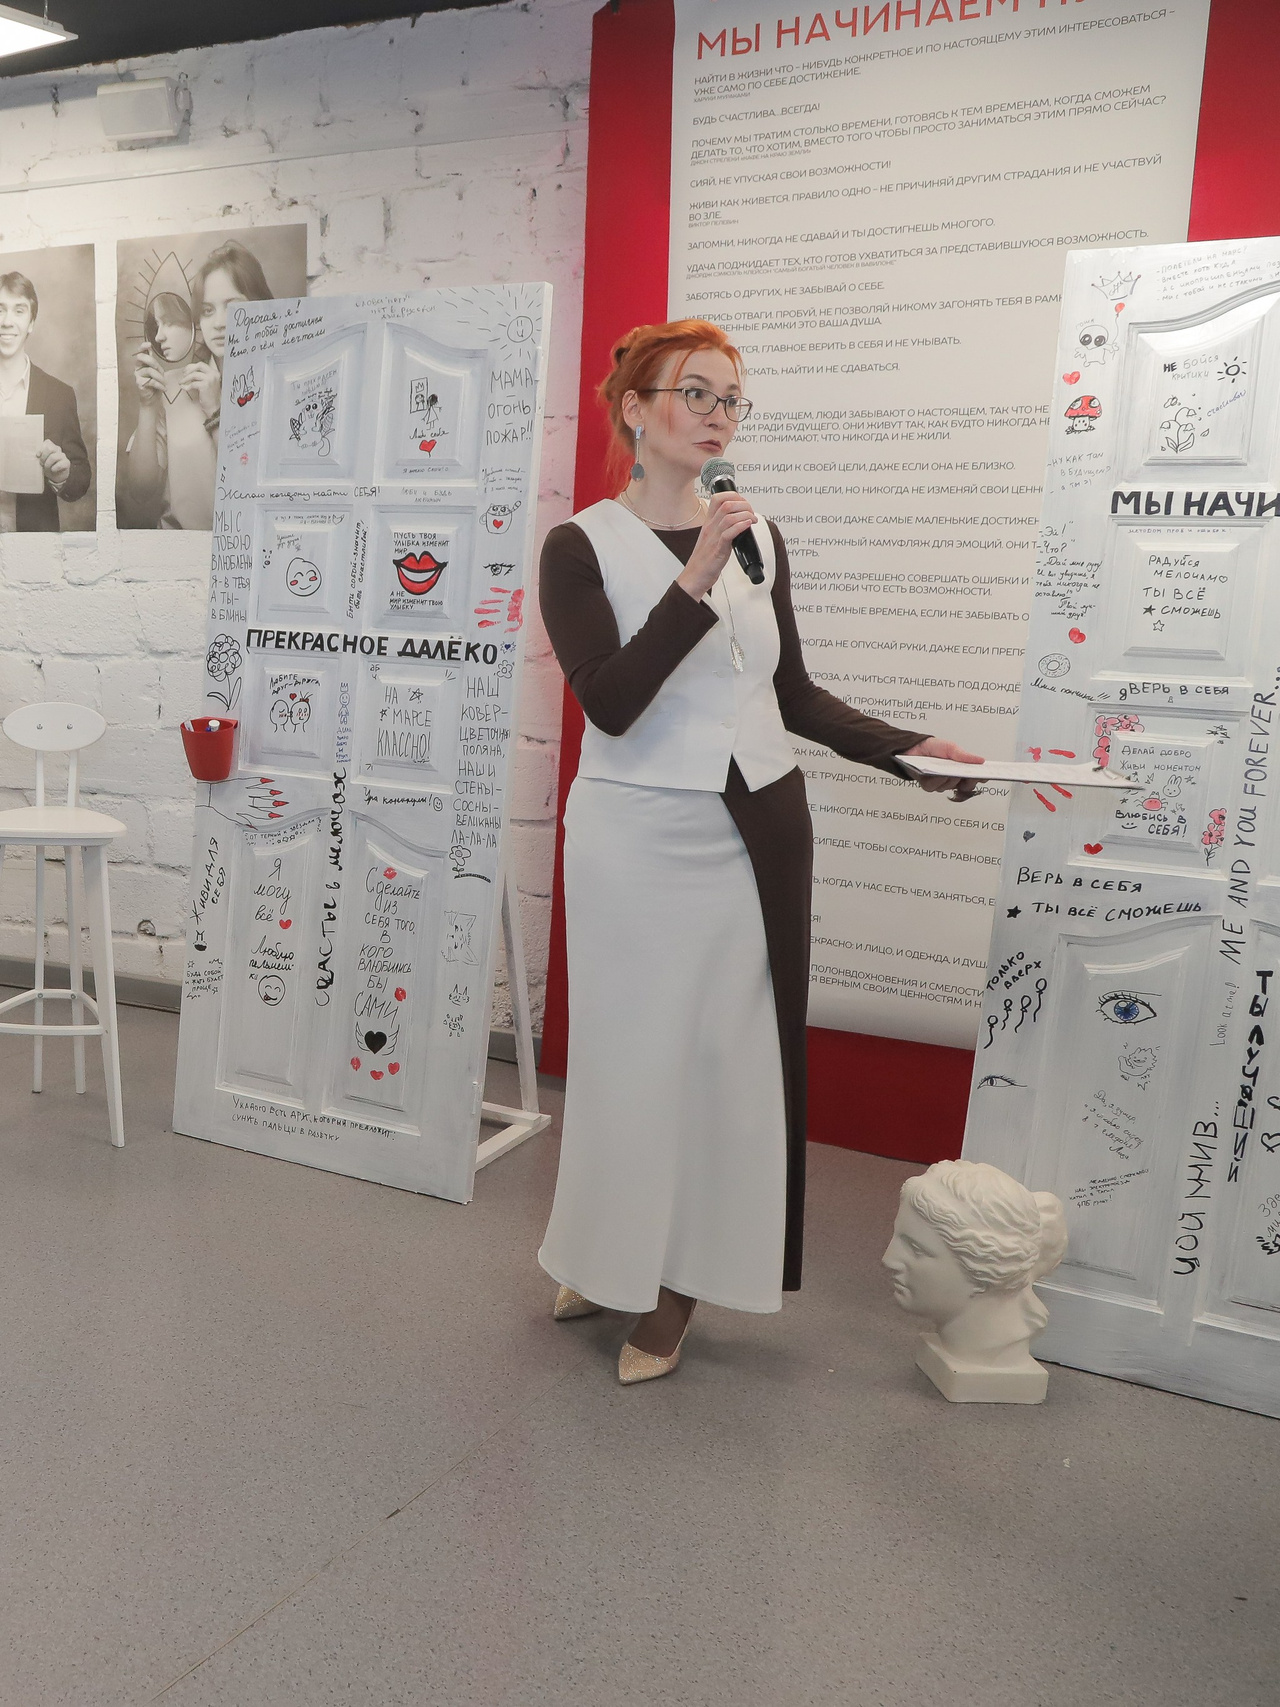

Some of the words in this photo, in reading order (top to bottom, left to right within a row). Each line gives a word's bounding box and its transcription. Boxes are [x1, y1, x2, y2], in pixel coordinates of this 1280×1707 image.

[694, 73, 726, 84] НАЙТИ
[728, 71, 735, 80] В
[737, 66, 772, 79] ЖИЗНИ
[774, 63, 794, 74] ЧТО
[802, 56, 842, 71] НИБУДЬ
[844, 46, 913, 64] КОНКРЕТНОЕ
[915, 45, 923, 53] И
[925, 42, 941, 52] ПО
[943, 30, 1022, 50] НАСТОЯЩЕМУ
[1023, 26, 1056, 38] ЭТИМ
[1058, 9, 1166, 33] ИНТЕРЕСОВАТЬСЯ
[697, 22, 761, 60] МЫ
[693, 86, 715, 95] УЖЕ
[716, 82, 746, 93] САМО
[747, 80, 762, 89] ПО
[763, 76, 787, 87] СЕБЕ
[690, 147, 727, 159] ДЕЛАТЬ
[745, 144, 764, 153] ЧТО
[803, 134, 844, 146] ВМЕСТО
[846, 131, 872, 142] ТОГО
[874, 126, 910, 138] ЧТОБЫ
[912, 121, 956, 134] ПРОСТО
[958, 112, 1031, 128] ЗАНИМАТЬСЯ
[1033, 108, 1065, 120] ЭТИМ
[1068, 103, 1111, 116] ПРЯМО
[1113, 94, 1166, 110] СЕЙЧАС?
[718, 176, 731, 184] НЕ
[733, 172, 778, 183] УПУСКАЯ
[779, 169, 806, 179] СВОИ
[808, 160, 891, 176] ВОЗМОЖНОСТИ!
[736, 235, 783, 247] НИКОГДА
[784, 234, 797, 242] НЕ
[799, 231, 839, 242] СДАВАЙ
[851, 229, 865, 237] ТЫ
[866, 222, 939, 236] ДОСТИГНЕШЬ
[686, 263, 716, 272] УДАЧА
[717, 258, 780, 270] ПОДЖИДАЕТ
[803, 255, 822, 264] КТО
[824, 252, 856, 262] ГОТОВ
[858, 248, 923, 260] УХВАТИТЬСЯ
[925, 246, 938, 255] ЗА
[939, 237, 1054, 254] ПРЕДСТАВИВШУЮСЯ
[1163, 362, 1178, 373] НЕ
[490, 367, 533, 394] МАМА
[488, 400, 531, 419] ОГОНЬ
[1111, 491, 1174, 516] МЫ
[214, 534, 251, 551] ТОБОЮ
[420, 532, 437, 540] ТВОЯ
[843, 572, 905, 581] РАЗРЕШЕНО
[906, 574, 970, 583] СОВЕРШАТЬ
[971, 576, 1019, 584] ОШИБКИ
[1143, 586, 1165, 598] ТЫ
[1173, 587, 1206, 600] ВСЁ
[1160, 605, 1221, 619] СМОЖЕШЬ
[246, 629, 389, 656] ПРЕКРАСНОЕ
[397, 635, 498, 665] ДАЛЁКО
[384, 685, 399, 704] НА
[467, 675, 499, 698] НАШ
[1179, 685, 1189, 695] В
[1195, 685, 1230, 695] СЕБЯ
[392, 708, 432, 727] МАРСЕ
[377, 727, 431, 759] КЛАССНО!
[458, 759, 496, 777] НАШИ
[456, 814, 502, 829] ВЕЛИКАНЫ
[819, 804, 864, 817] НИКОГДА
[865, 809, 879, 818] НЕ
[880, 810, 928, 823] ЗАБЫВАЙ
[930, 815, 951, 825] ПРО
[953, 818, 979, 828] СЕБЯ
[1177, 815, 1187, 824] В
[1148, 823, 1187, 838] СЕБЯ!
[1233, 805, 1257, 847] YOU
[1072, 877, 1083, 887] В
[1090, 879, 1143, 893] СЕБЯ
[1227, 859, 1251, 909] AND
[364, 912, 390, 928] СЕБЯ
[1032, 902, 1059, 914] ТЫ
[1067, 906, 1099, 918] ВСЁ
[1105, 902, 1202, 922] СМОЖЕШЬ
[380, 930, 391, 944] В
[1219, 918, 1247, 966] ME
[359, 943, 394, 959] КОГО
[367, 974, 388, 993] БЫ
